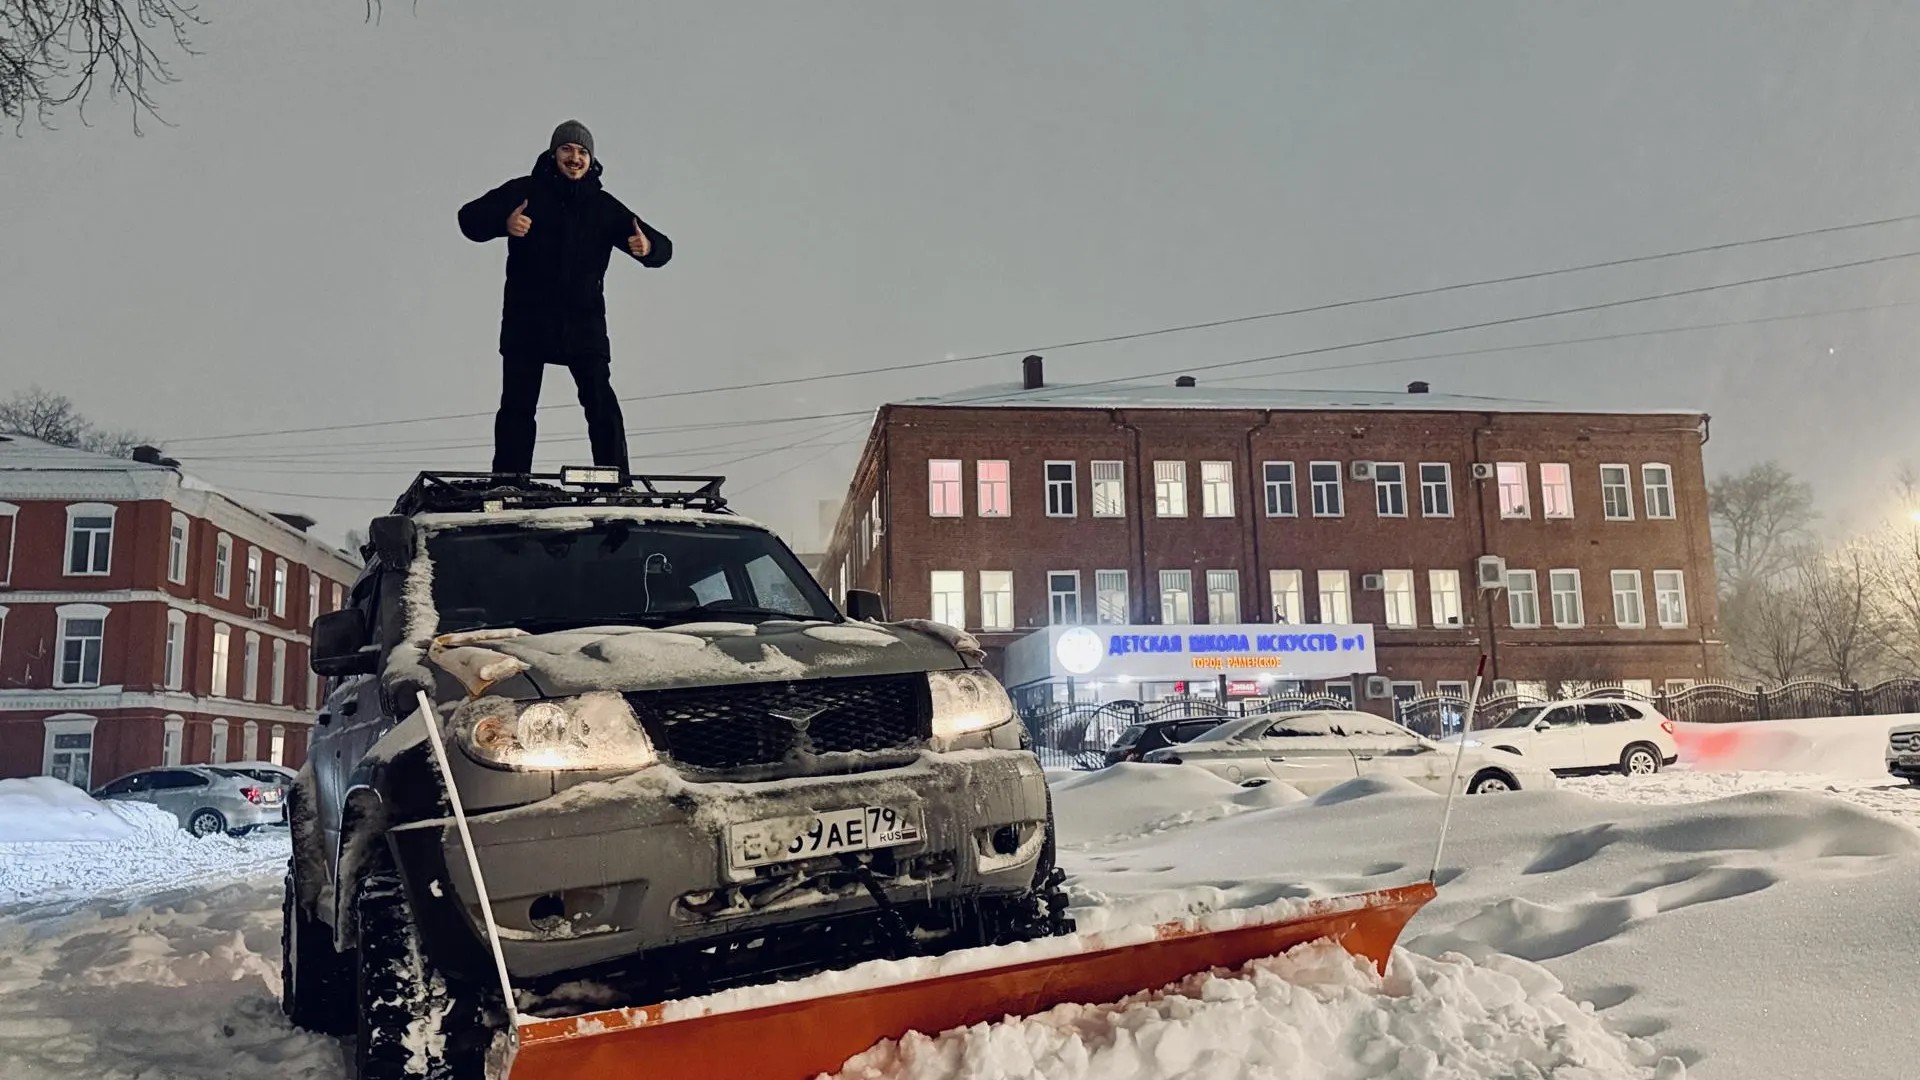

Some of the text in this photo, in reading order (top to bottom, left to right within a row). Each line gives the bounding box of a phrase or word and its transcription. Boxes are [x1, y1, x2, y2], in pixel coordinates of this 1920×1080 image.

[1109, 634, 1182, 655] ДЕТСКАЯ
[1189, 634, 1249, 652] ШКОЛА
[1257, 634, 1337, 652] ИСКУССТВ
[1192, 656, 1281, 669] ГОРОД РАМЕНСКОЕ
[879, 831, 902, 842] RUS
